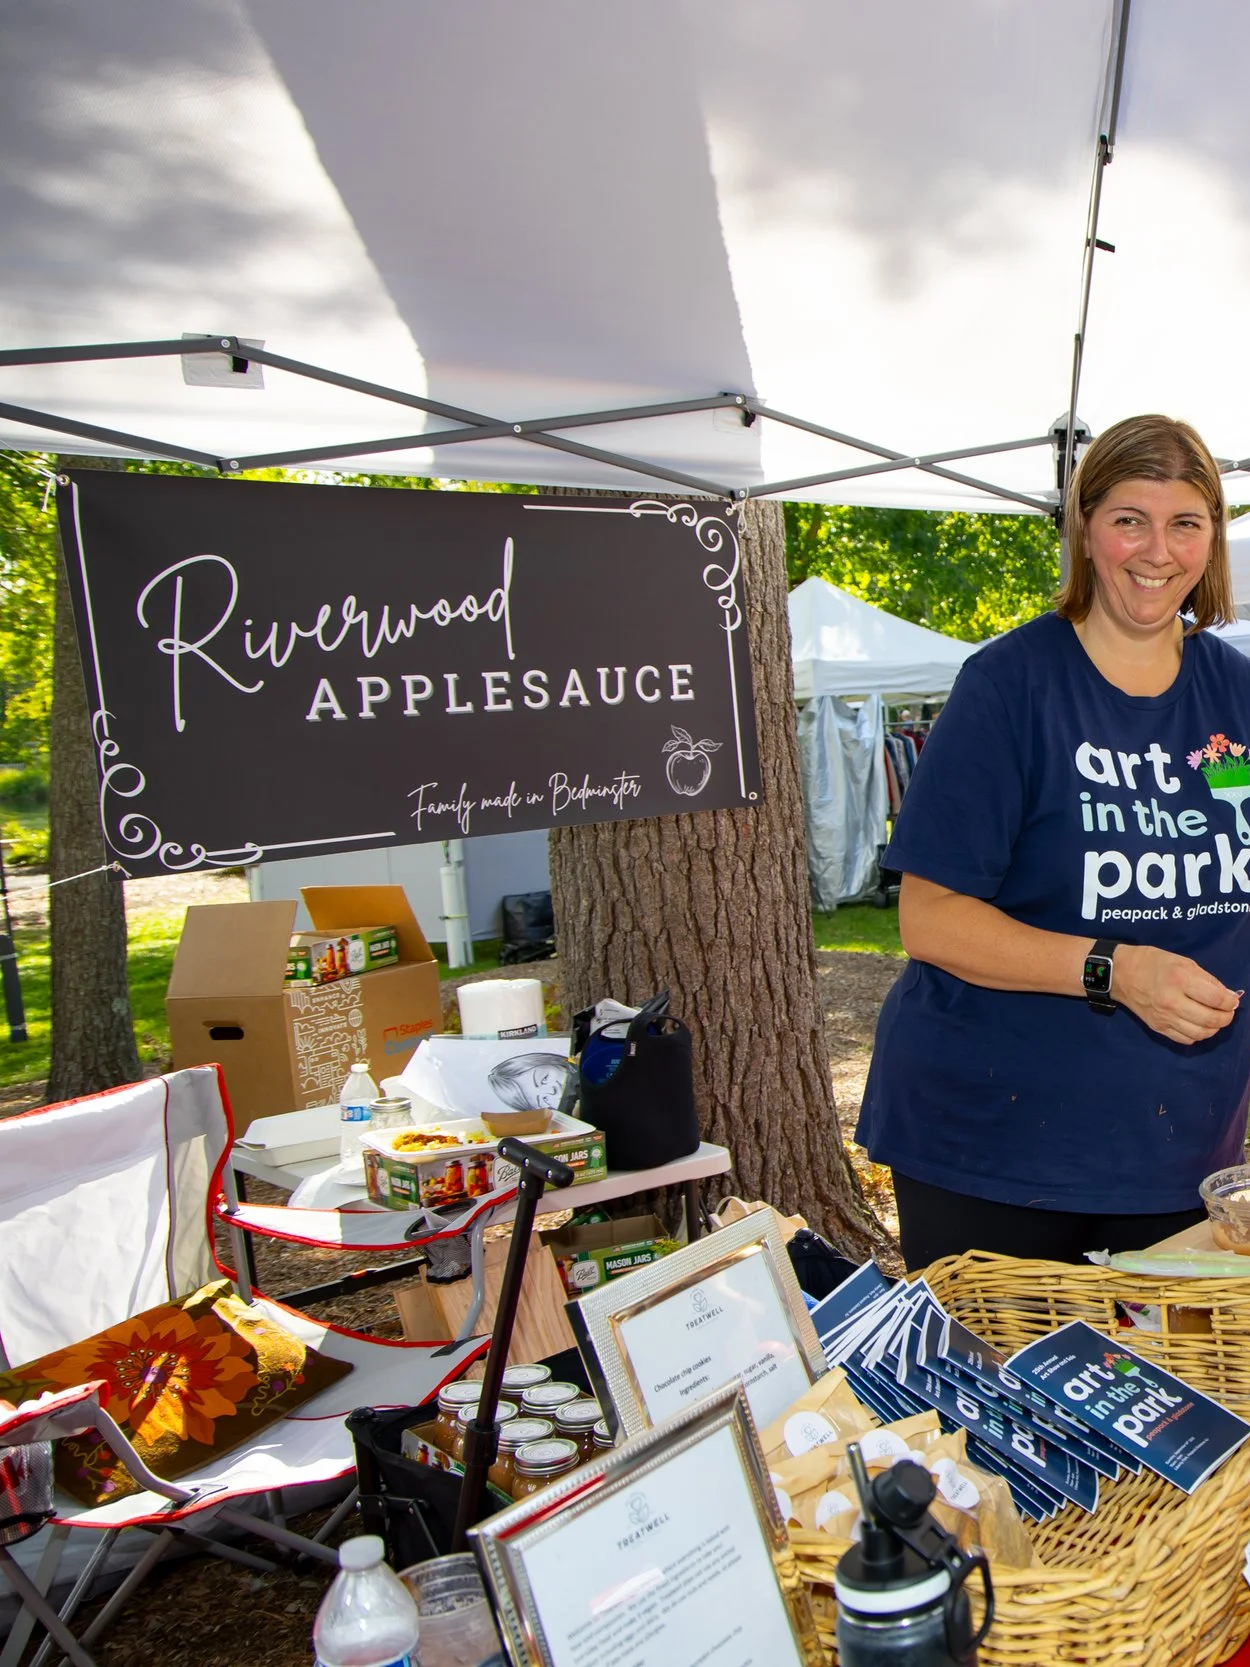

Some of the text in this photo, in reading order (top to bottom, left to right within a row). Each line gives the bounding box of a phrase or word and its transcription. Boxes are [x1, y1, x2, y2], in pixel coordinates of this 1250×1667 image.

[137, 537, 514, 732] Riverwood
[305, 664, 695, 721] APPLESAUCE
[1075, 741, 1181, 794] art
[407, 770, 642, 834] Family made in Bedminster
[1079, 791, 1208, 839] in the
[1101, 906, 1169, 923] peapack
[1172, 906, 1183, 919] &
[399, 1019, 434, 1035] Staples
[500, 1025, 537, 1038] KIRKLAND
[570, 1150, 589, 1163] JARS
[576, 1265, 595, 1281] Ball
[606, 1253, 651, 1271] MASON JARS
[685, 1306, 724, 1331] TREATWELL
[654, 1356, 712, 1392] Chocolate chip cookies
[680, 1375, 711, 1396] Ingredients:
[745, 1370, 769, 1387] ornstarch,
[1040, 1371, 1050, 1381] Art
[1063, 1363, 1115, 1400] art
[1084, 1400, 1115, 1420] in
[1106, 1383, 1140, 1403] the
[1112, 1388, 1182, 1448] park
[1146, 1419, 1169, 1441] peapack
[616, 1513, 670, 1550] TREATWELL
